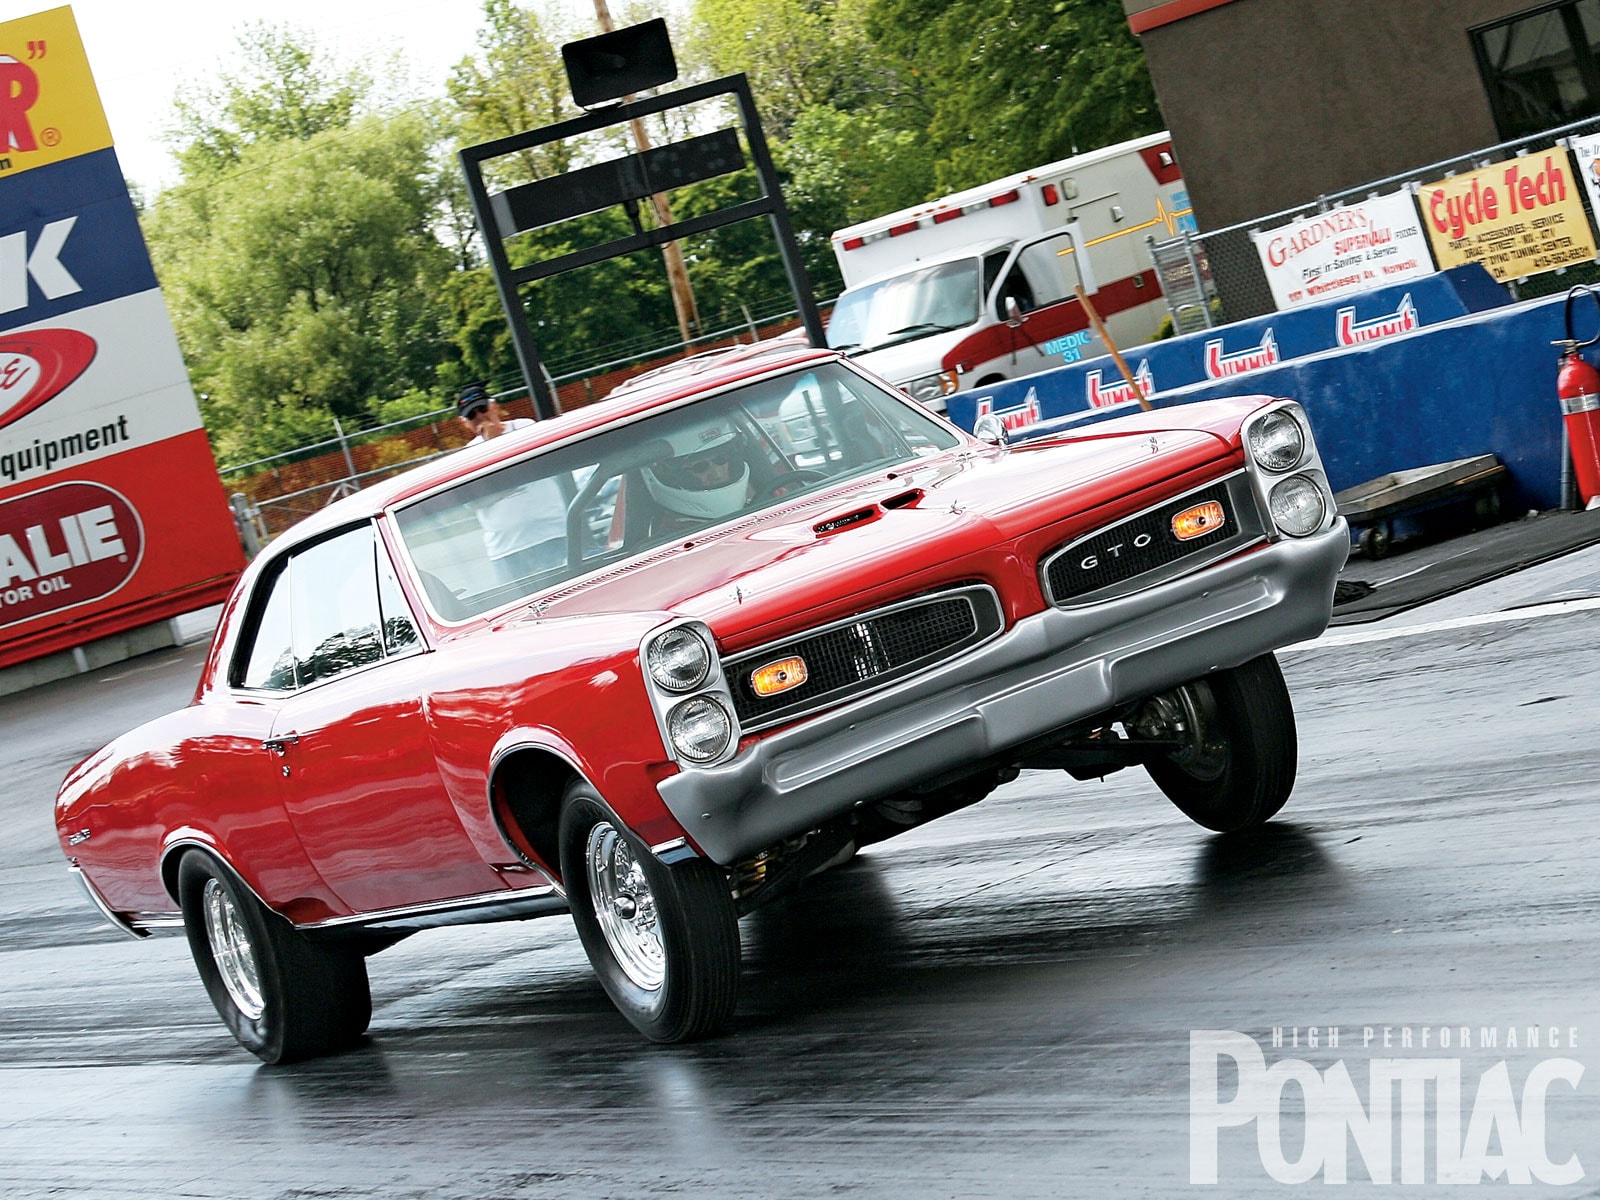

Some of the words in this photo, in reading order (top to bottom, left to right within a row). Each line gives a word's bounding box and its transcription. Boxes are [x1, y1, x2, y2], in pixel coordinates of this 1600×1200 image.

[1430, 178, 1498, 239] Cycle
[1504, 156, 1567, 215] Tech
[1531, 213, 1565, 230] SERVICE
[1267, 208, 1369, 268] GARDNER'S
[1488, 238, 1516, 253] STREET
[1510, 245, 1541, 260] TUNING
[1541, 237, 1573, 252] CENTER
[1044, 330, 1092, 355] MEDIC
[1063, 347, 1082, 363] 31
[1080, 533, 1152, 571] GTO
[37, 575, 72, 595] OIL
